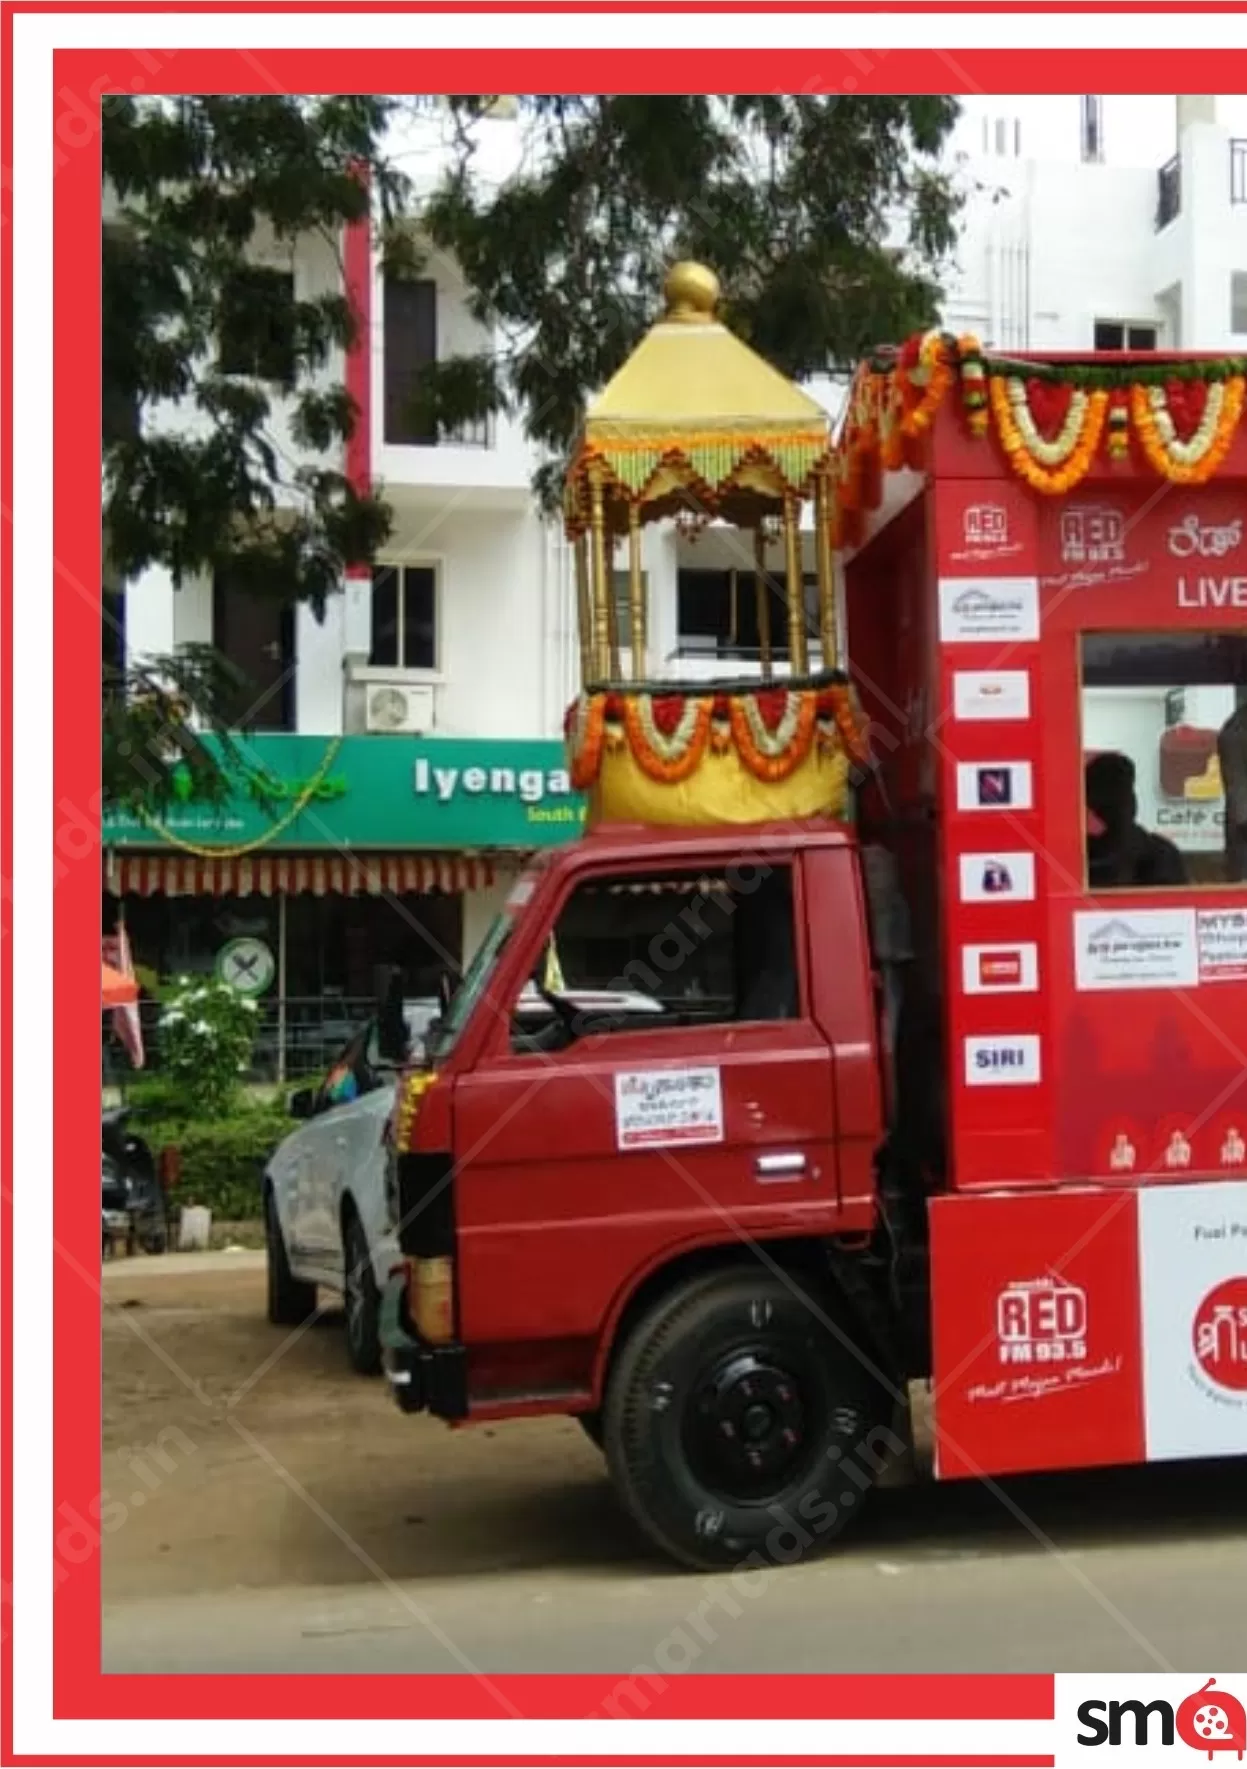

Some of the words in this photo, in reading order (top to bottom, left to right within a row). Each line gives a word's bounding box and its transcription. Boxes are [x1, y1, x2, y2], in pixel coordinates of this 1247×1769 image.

[415, 758, 571, 801] Iyenga
[976, 1049, 1024, 1068] SIRI
[1195, 1224, 1225, 1240] Fuel
[1002, 1288, 1084, 1339] RED
[1000, 1342, 1031, 1362] FM
[1036, 1340, 1086, 1360] 93.5
